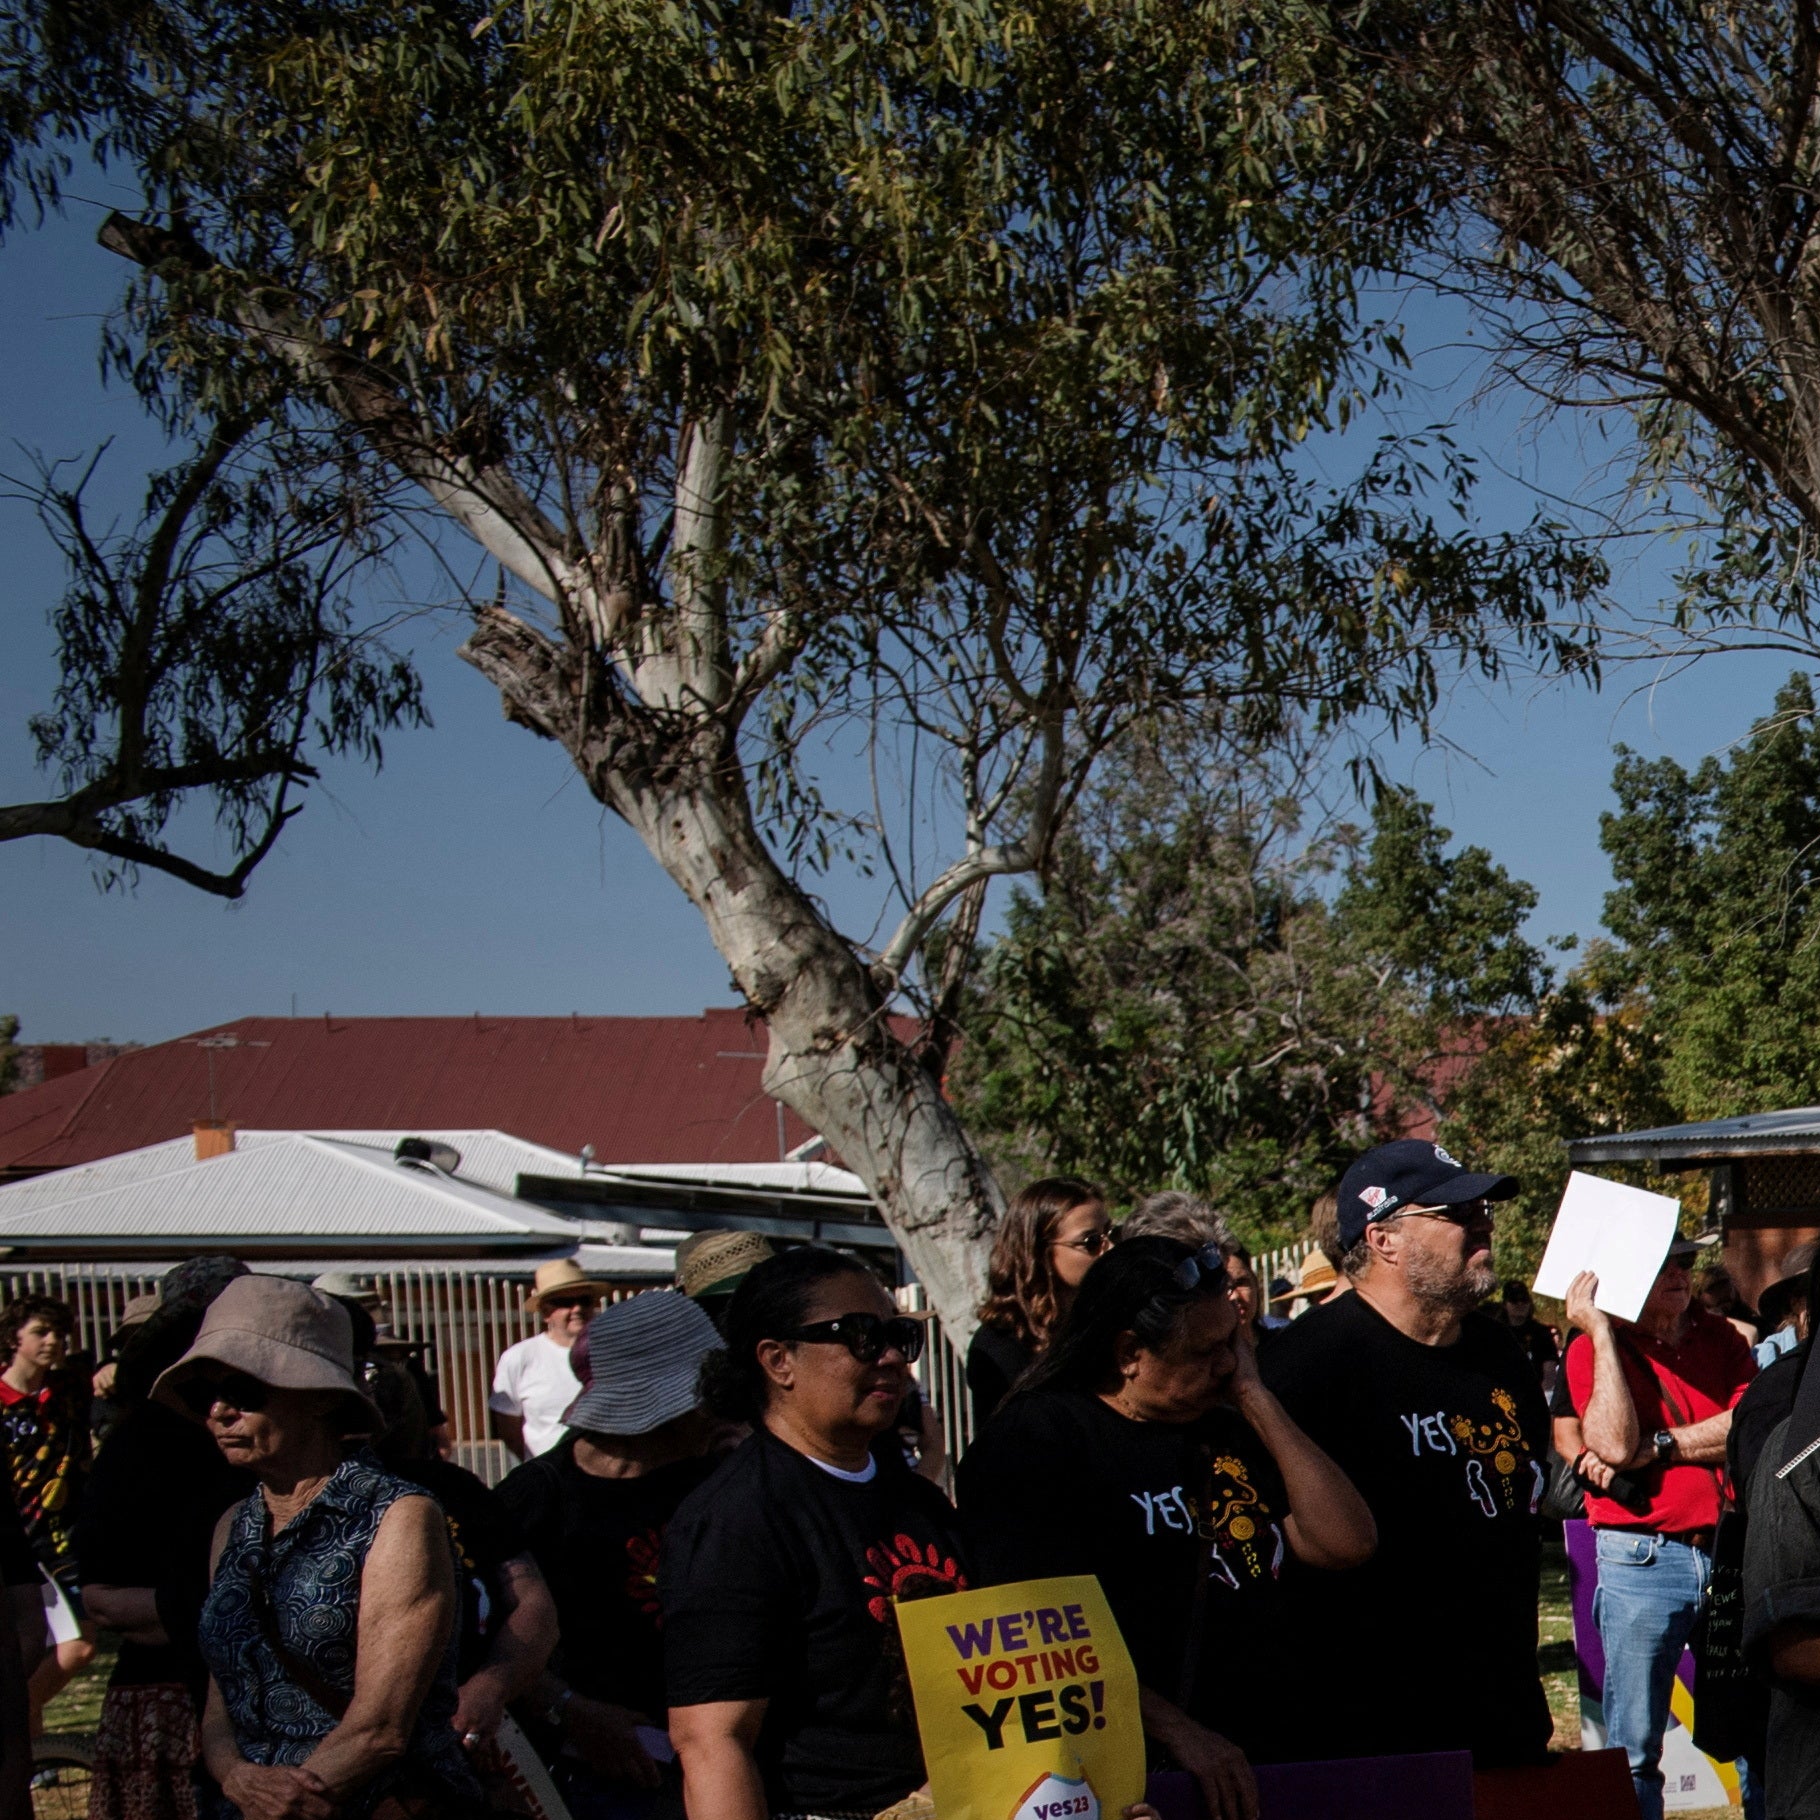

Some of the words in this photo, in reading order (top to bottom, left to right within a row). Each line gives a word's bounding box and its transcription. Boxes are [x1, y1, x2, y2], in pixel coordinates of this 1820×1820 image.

[1400, 1410, 1457, 1457] YES
[1130, 1485, 1194, 1536] YES
[945, 1603, 1092, 1660] WE'RE
[956, 1644, 1100, 1696] VOTING
[960, 1680, 1107, 1750] YES!
